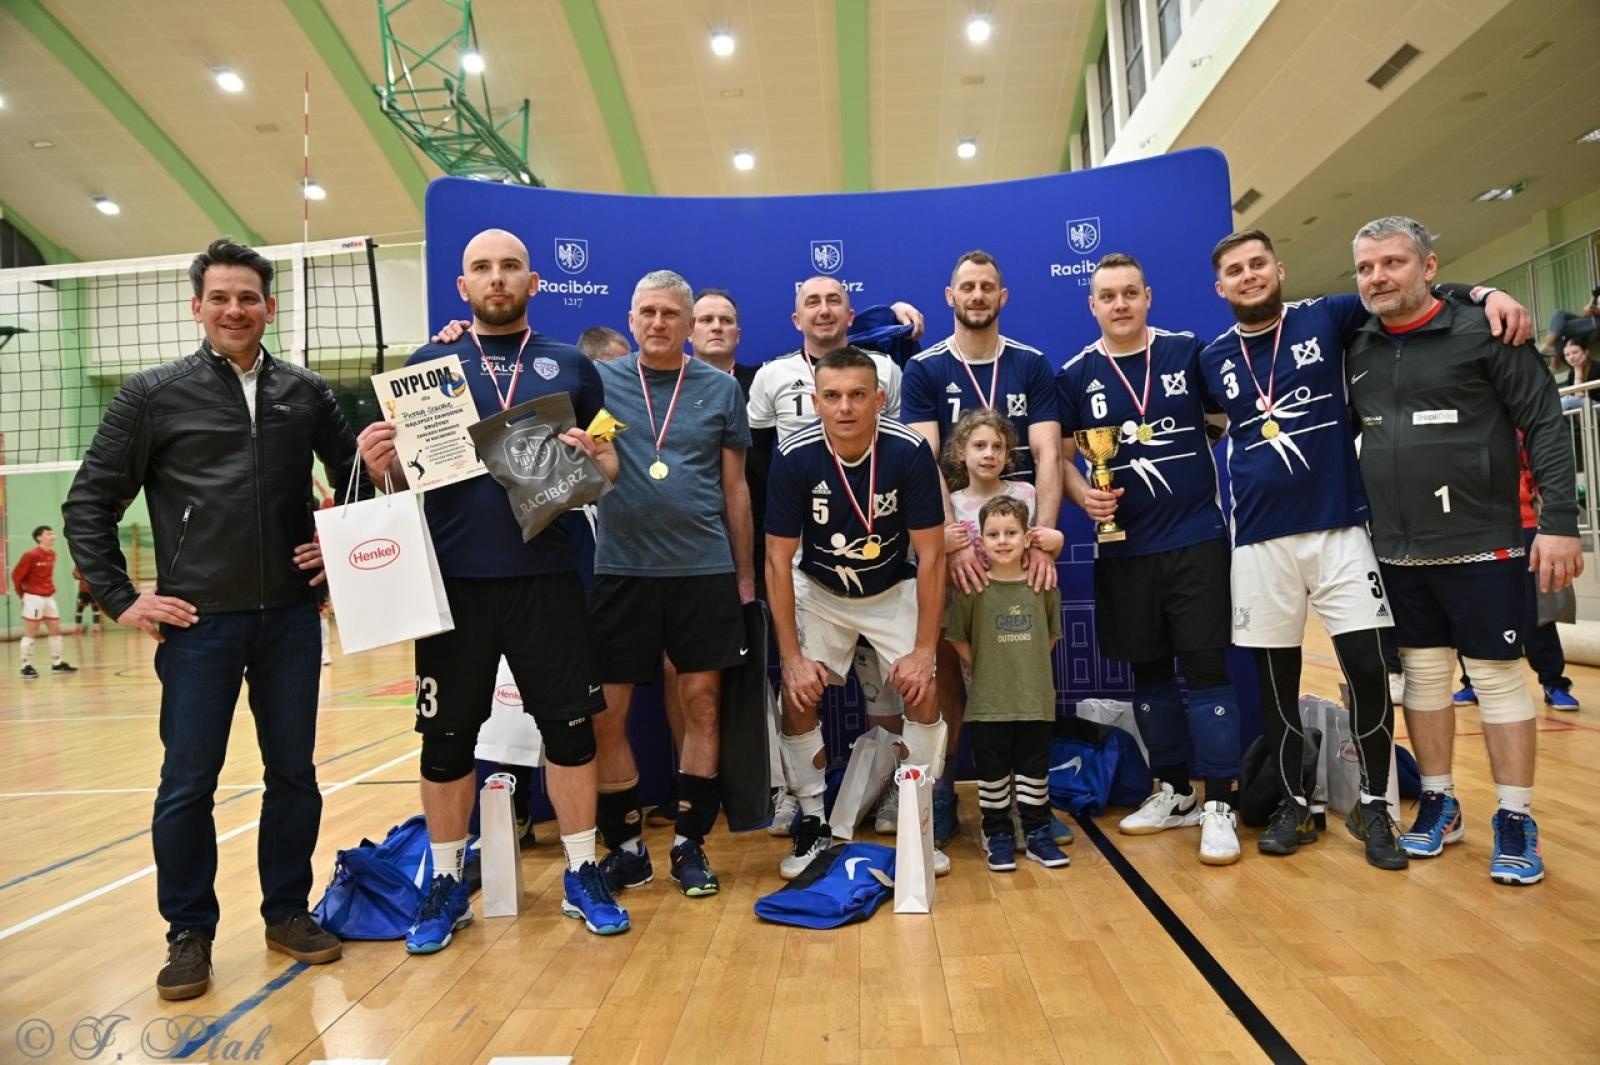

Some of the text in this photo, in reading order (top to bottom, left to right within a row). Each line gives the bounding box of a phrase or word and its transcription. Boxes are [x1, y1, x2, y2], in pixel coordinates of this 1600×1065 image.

[1050, 259, 1097, 277] Racib
[538, 279, 609, 295] Racibórz
[564, 297, 583, 308] 1217
[390, 366, 454, 398] DYPLOM
[1223, 372, 1240, 400] 3
[792, 394, 803, 416] 1
[948, 398, 961, 423] 7
[1091, 393, 1108, 419] 6
[520, 466, 588, 514] RACIBÓRZ
[1434, 485, 1451, 513] 1
[812, 497, 830, 525] 5
[353, 544, 396, 564] Henkel
[1367, 571, 1384, 599] 3
[995, 614, 1033, 632] GREAT
[998, 632, 1032, 643] OUTDOORS
